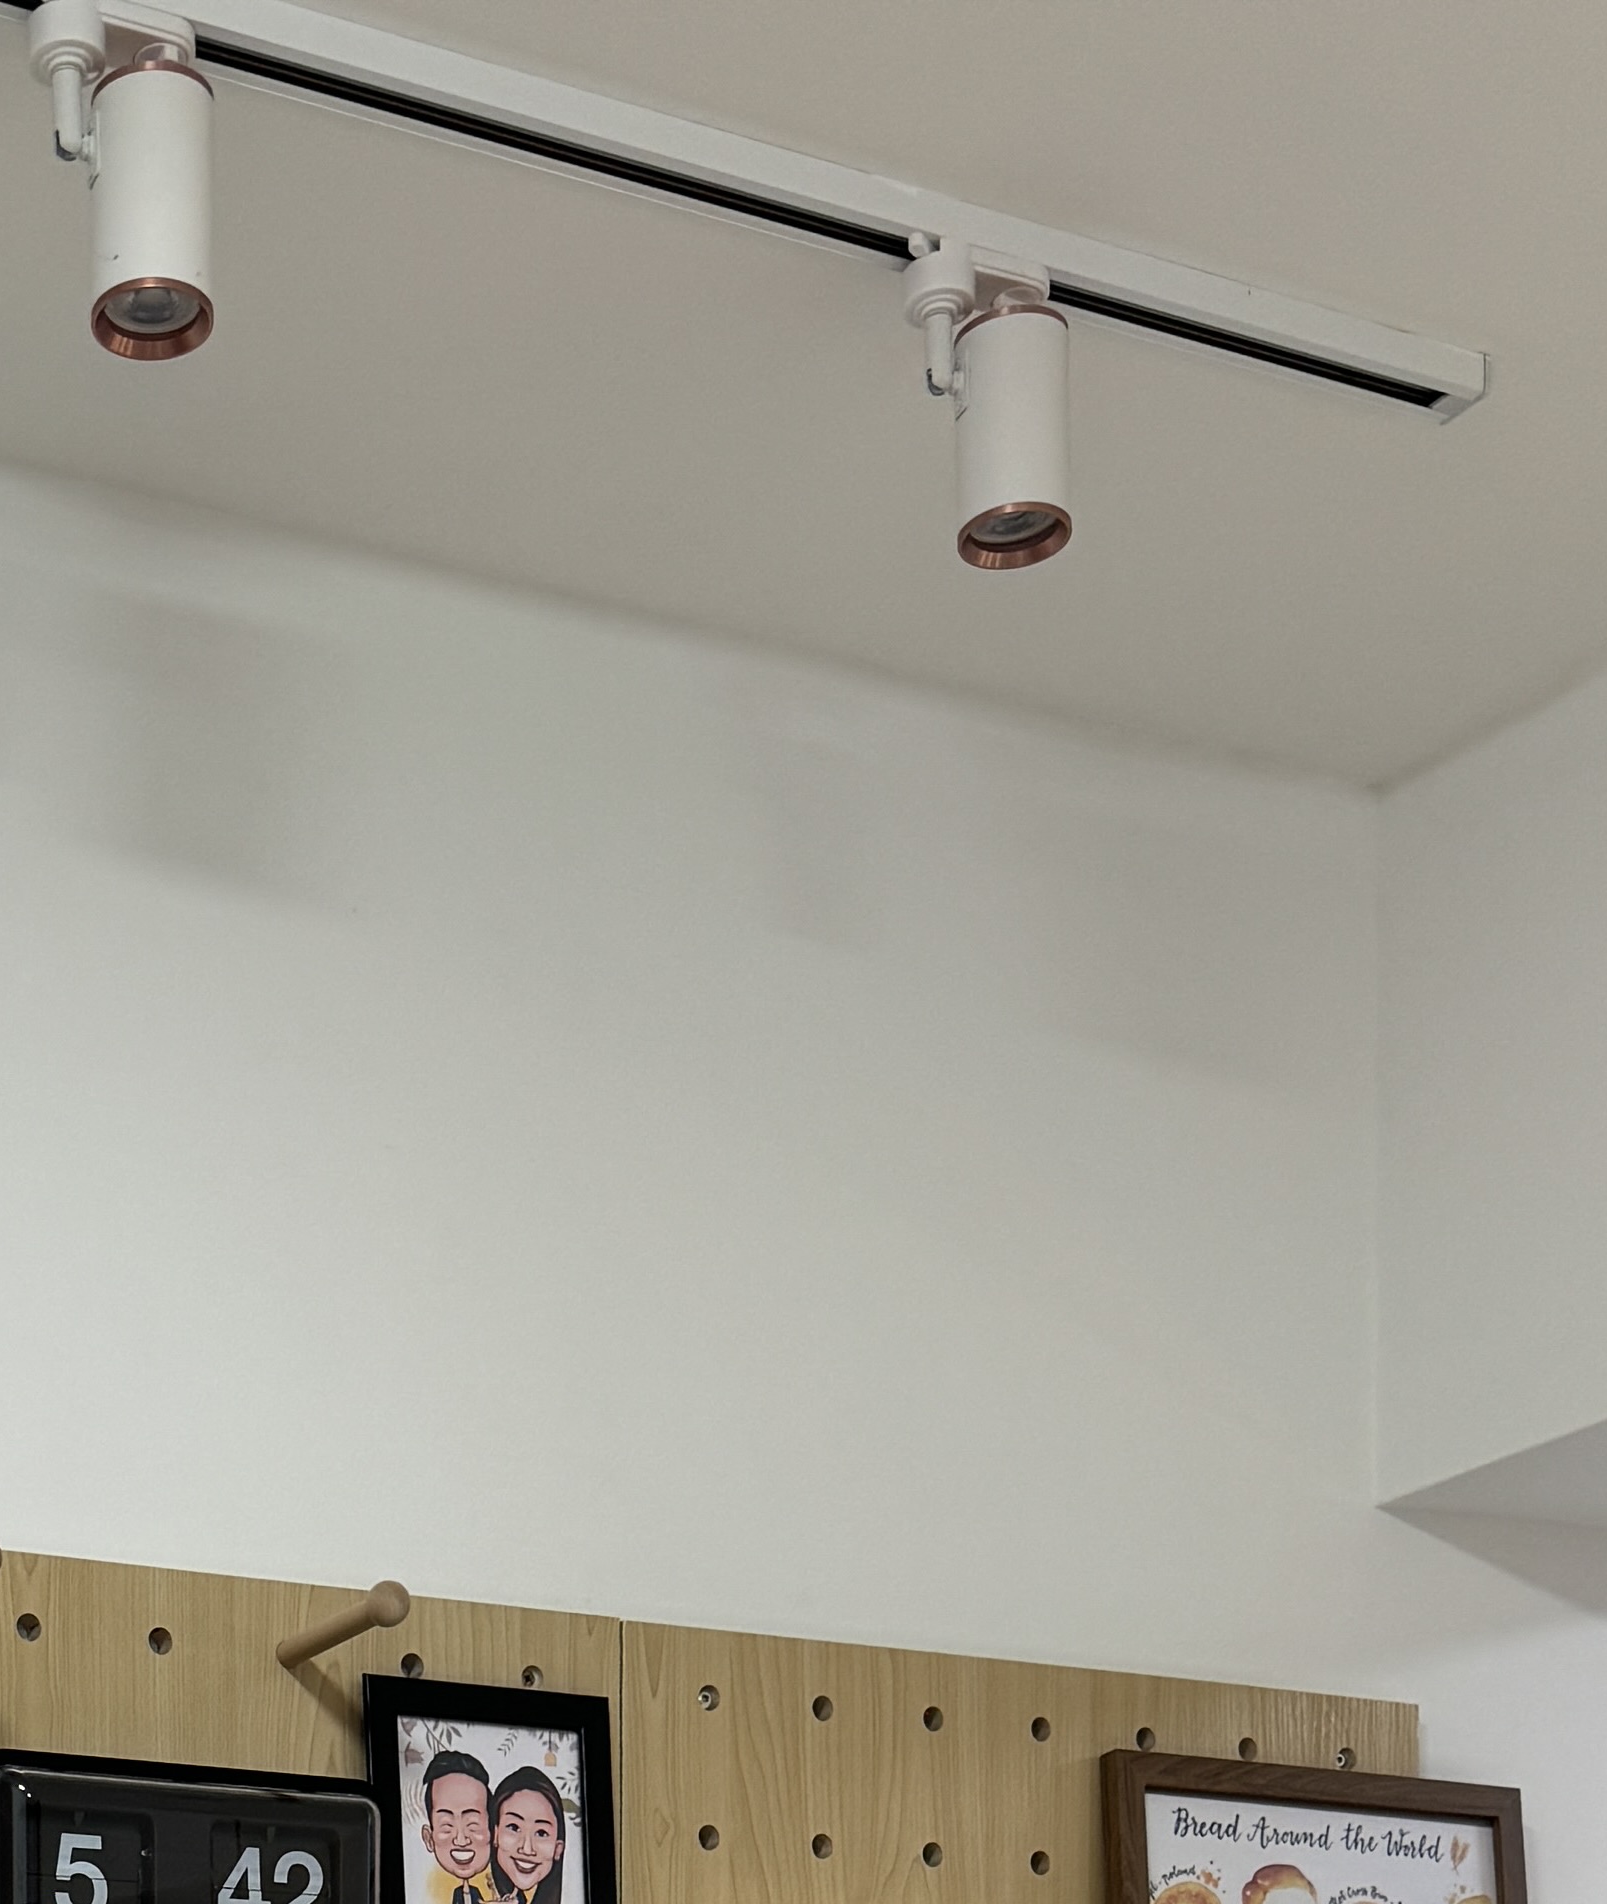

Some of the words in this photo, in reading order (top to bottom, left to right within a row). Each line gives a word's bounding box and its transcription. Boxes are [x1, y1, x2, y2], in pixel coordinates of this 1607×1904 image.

[1172, 1808, 1242, 1843] Bread
[1247, 1816, 1334, 1852] Around
[1341, 1823, 1379, 1854] the
[1382, 1832, 1444, 1863] World
